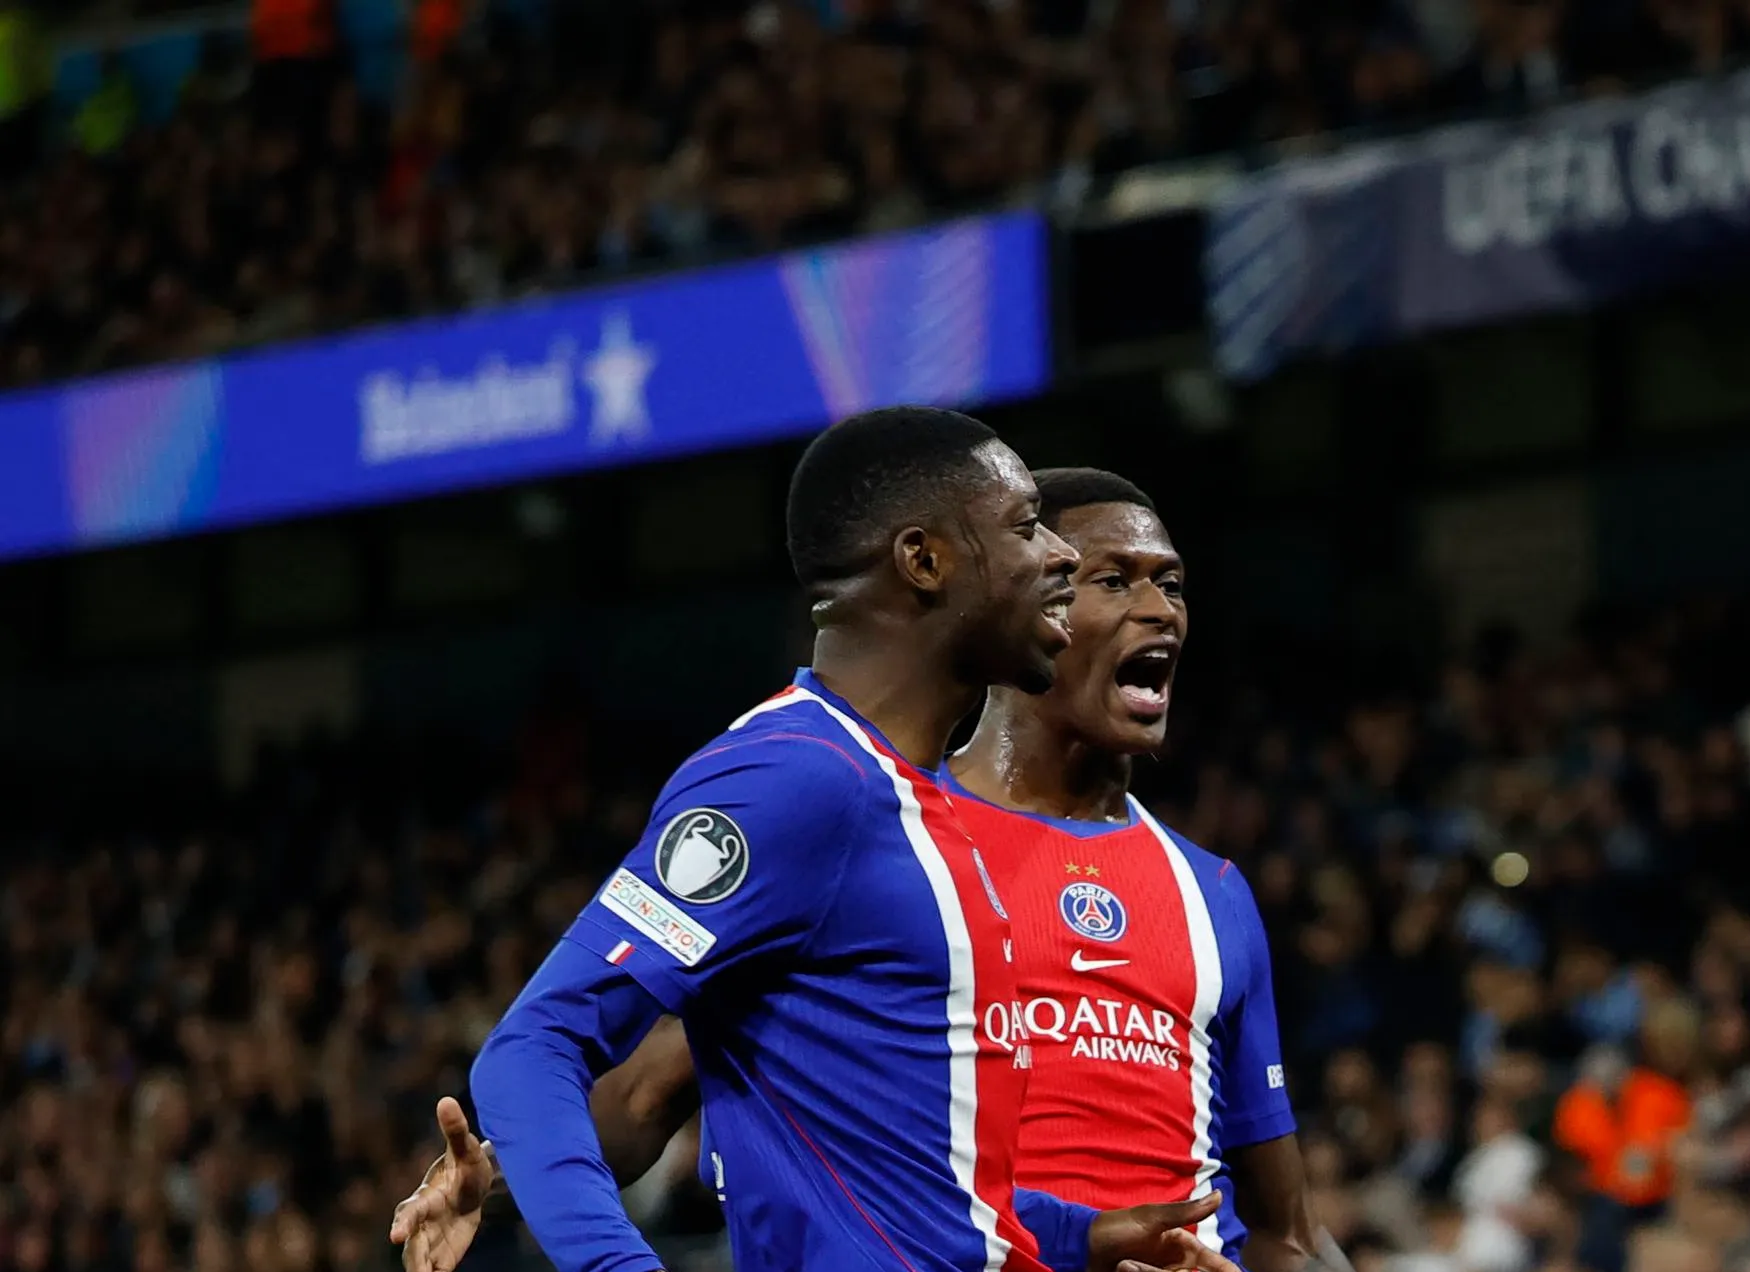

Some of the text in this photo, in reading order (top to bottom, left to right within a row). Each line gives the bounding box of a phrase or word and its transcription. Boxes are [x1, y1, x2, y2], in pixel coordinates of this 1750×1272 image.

[611, 879, 706, 956] FOUNDATION
[1067, 886, 1112, 905] PARIS
[1024, 996, 1180, 1048] QATAR
[1071, 1035, 1182, 1072] AIRWAYS
